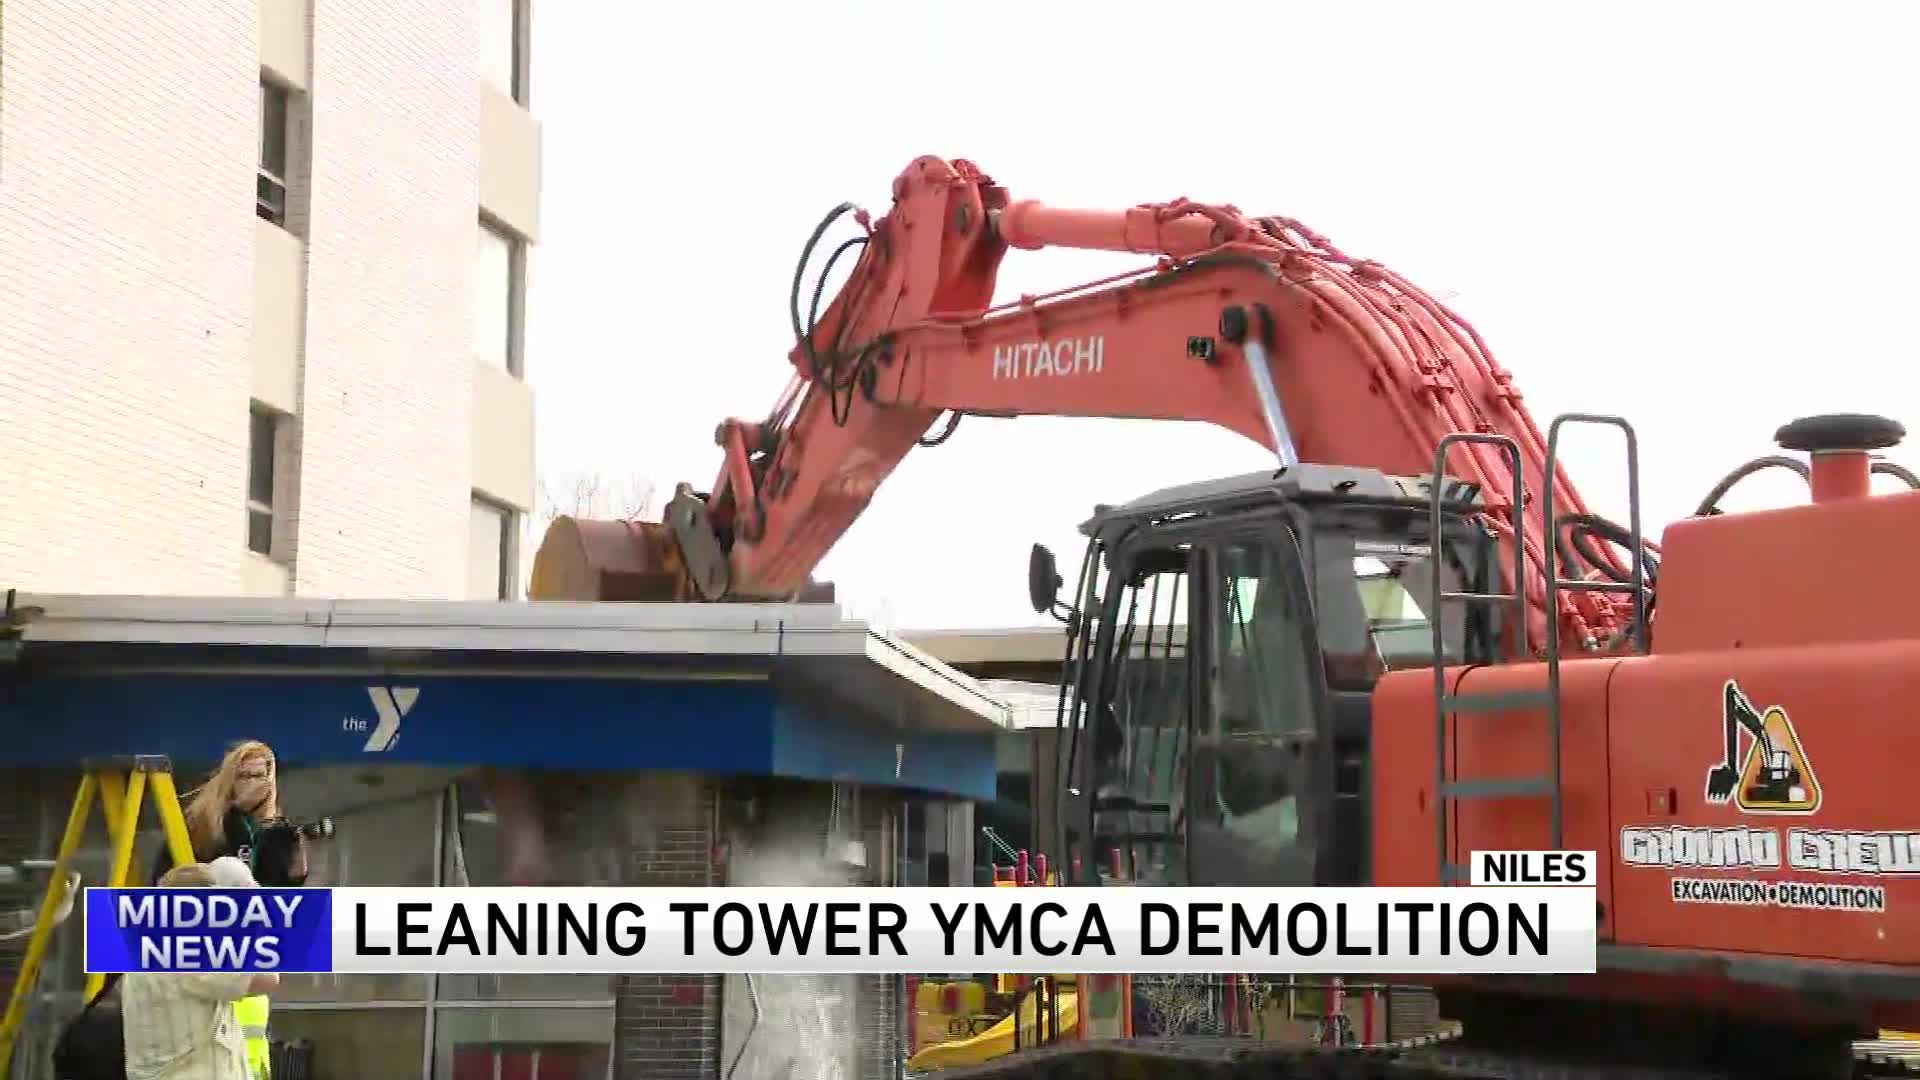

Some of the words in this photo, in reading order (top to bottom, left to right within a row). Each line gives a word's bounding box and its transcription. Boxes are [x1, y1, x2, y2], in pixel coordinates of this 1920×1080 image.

[993, 336, 1104, 379] HITACHI
[342, 716, 368, 732] the
[1622, 826, 1780, 869] GROUND
